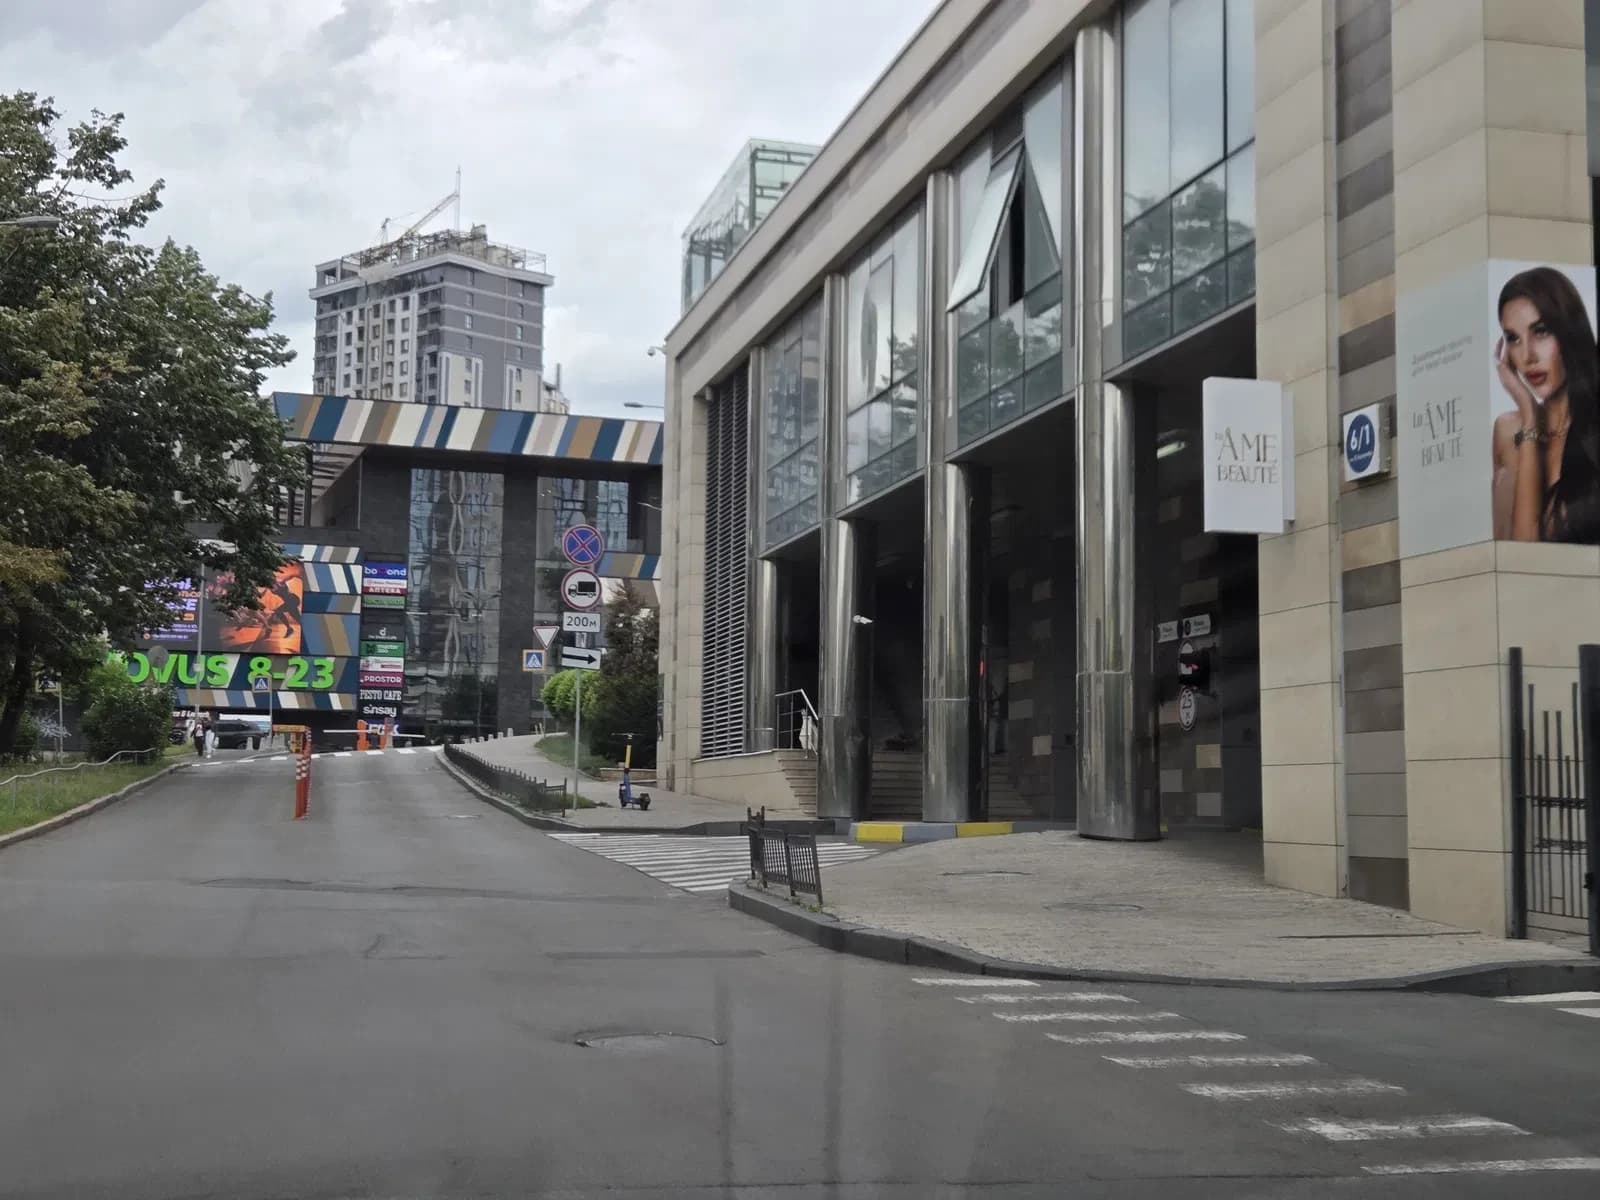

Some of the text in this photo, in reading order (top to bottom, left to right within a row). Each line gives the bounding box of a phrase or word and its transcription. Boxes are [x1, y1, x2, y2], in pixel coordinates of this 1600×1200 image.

[1350, 423, 1370, 452] 6/1
[109, 650, 335, 690] OVUS 8-23
[363, 704, 397, 718] sinsay
